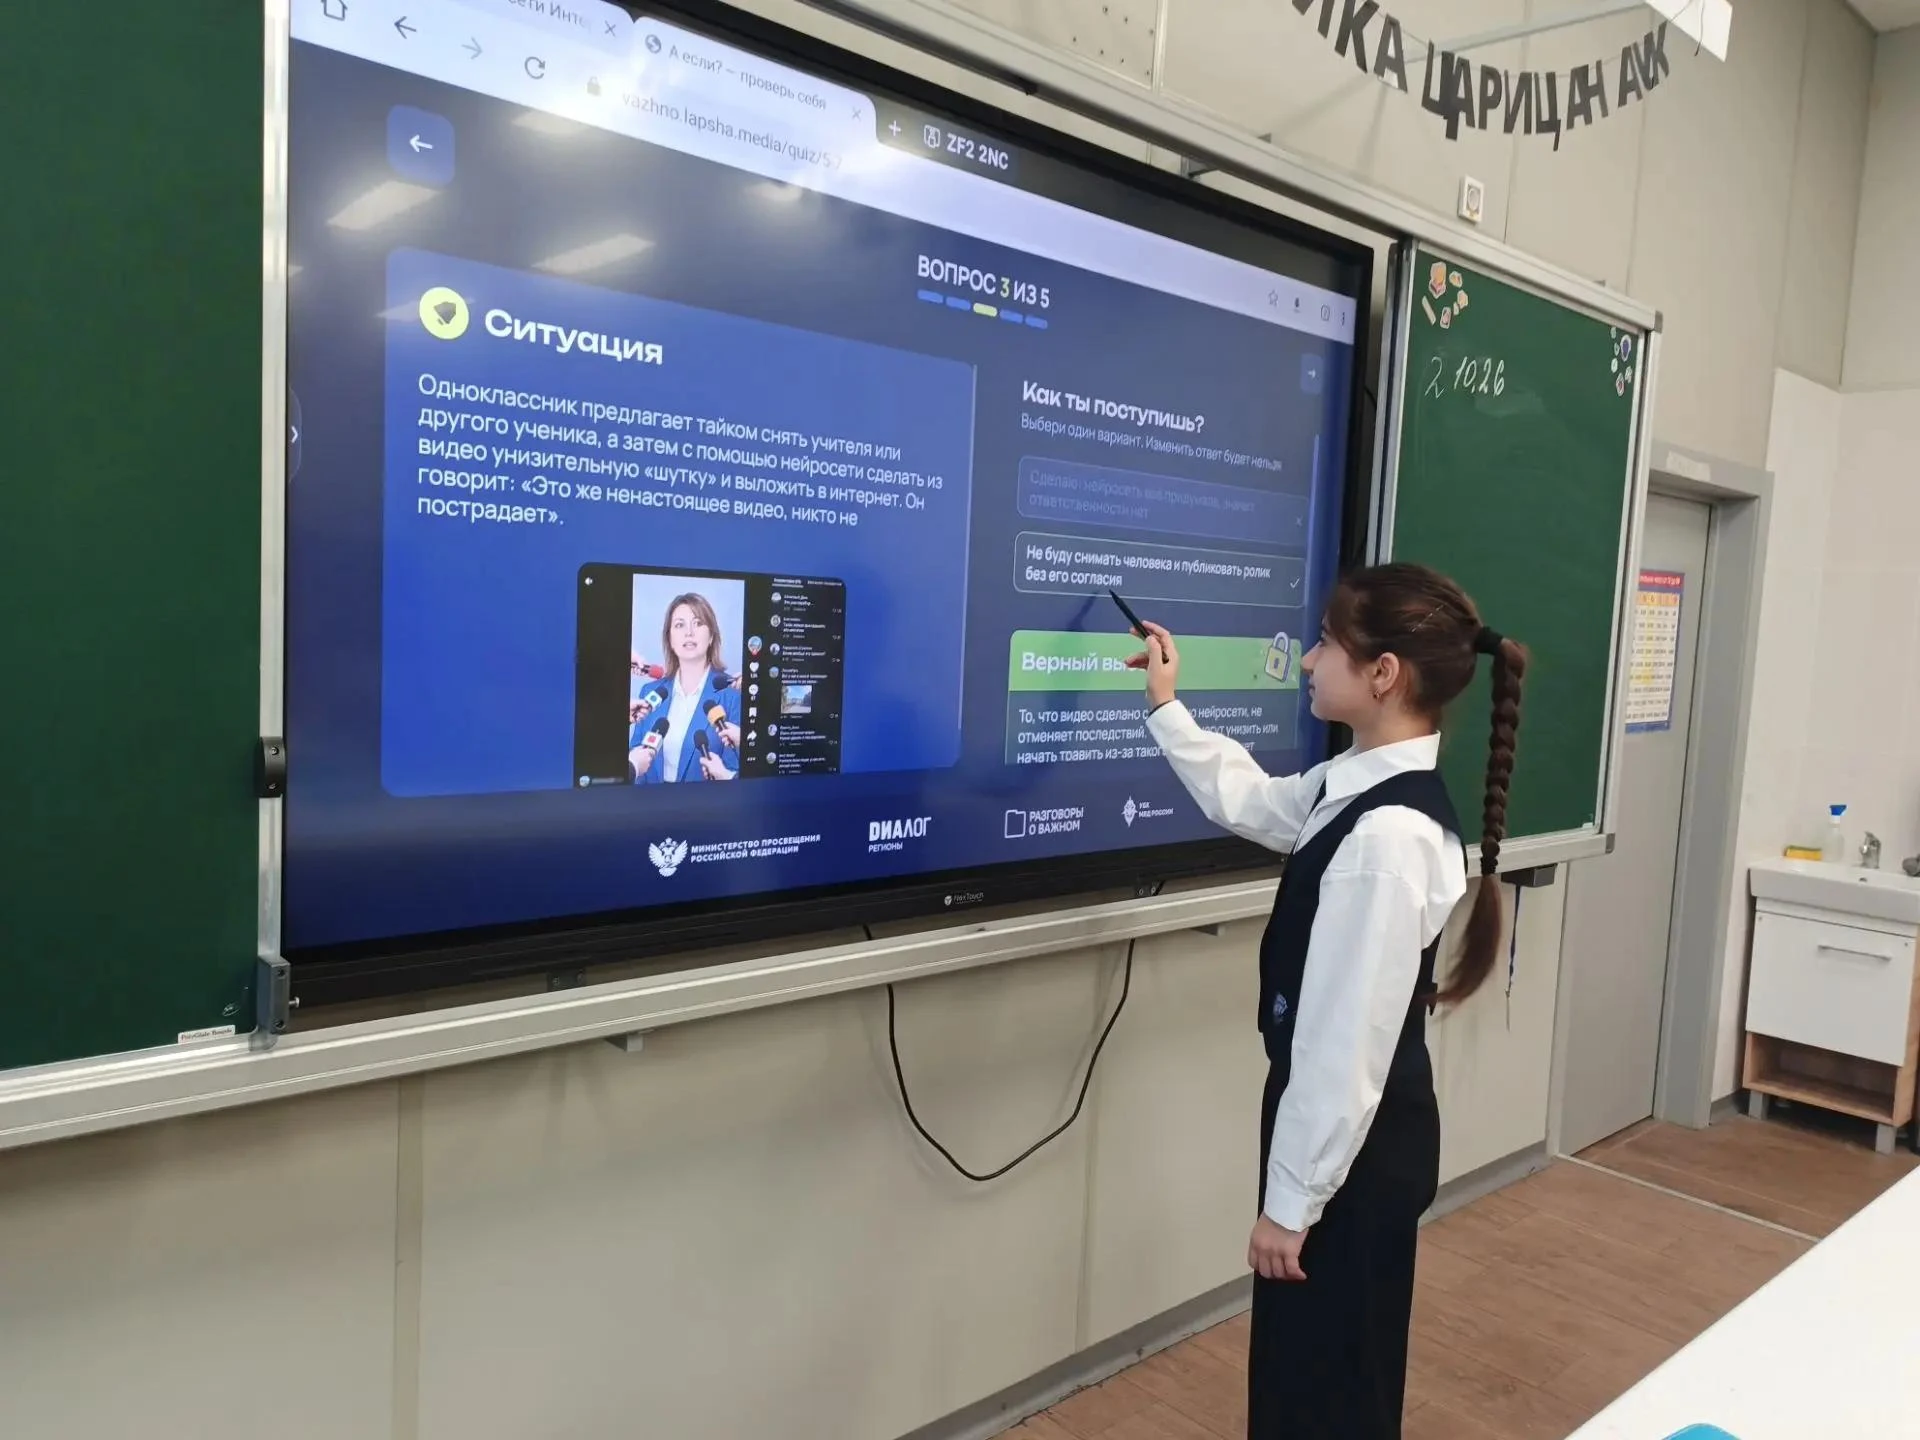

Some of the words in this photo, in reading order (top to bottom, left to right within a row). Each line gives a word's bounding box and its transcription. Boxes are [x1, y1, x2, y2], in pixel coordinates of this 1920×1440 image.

[669, 44, 680, 60] А
[682, 52, 723, 73] если?
[740, 69, 795, 101] проверь
[797, 91, 827, 110] себя
[947, 132, 975, 159] ZF2
[979, 142, 1009, 170] 2NC
[917, 254, 997, 294] ВОПРОС
[1000, 276, 1010, 298] 3
[1013, 280, 1037, 305] ИЗ
[1040, 287, 1050, 309] 5
[484, 308, 663, 365] Ситуация
[1424, 356, 1445, 399] 2
[418, 373, 578, 416] Одноклассник
[581, 401, 694, 432] предлагает
[696, 416, 758, 441] тайком
[761, 428, 808, 448] снять
[811, 435, 872, 457] учителя
[875, 444, 901, 461] или
[1022, 380, 1062, 408] Как
[1064, 392, 1090, 413] ты
[1093, 398, 1205, 433] поступишь?
[418, 407, 509, 434] другого
[513, 420, 602, 449] ученика,
[607, 433, 619, 449] а
[622, 435, 678, 456] затем
[682, 443, 693, 458] с
[696, 444, 778, 469] помощью
[780, 455, 864, 480] нейросети
[866, 467, 925, 487] сделать
[927, 475, 943, 490] из
[1021, 412, 1066, 437] Выбери
[1067, 424, 1096, 440] один
[1097, 429, 1144, 448] вариант.
[1195, 447, 1223, 461] ответ
[1223, 448, 1251, 466] будет
[418, 437, 488, 462] видео
[492, 446, 640, 481] унизительную
[644, 466, 717, 490] «шутку»
[721, 473, 732, 489] и
[735, 475, 815, 498] выложить
[818, 485, 827, 499] в
[829, 487, 903, 508] интернет.
[905, 492, 925, 510] Он
[417, 497, 564, 526] пострадает».
[418, 467, 515, 495] говорит:
[521, 475, 571, 498] «Это
[575, 483, 603, 501] же
[606, 487, 730, 513] ненастоящее
[734, 500, 787, 521] видео,
[791, 506, 837, 524] никто
[839, 511, 858, 527] не
[1025, 565, 1047, 582] без
[1048, 569, 1069, 583] его
[1070, 571, 1123, 587] согласия
[1026, 544, 1043, 561] Не
[1044, 545, 1073, 567] буду
[1074, 550, 1122, 567] снимать
[1122, 555, 1172, 572] человека
[1173, 560, 1181, 572] и
[1181, 559, 1243, 577] публиковать
[1243, 565, 1272, 580] ролик
[1021, 651, 1098, 674] Верный
[1018, 708, 1036, 725] То,
[1038, 710, 1059, 723] что
[1060, 710, 1094, 724] видео
[1095, 708, 1141, 723] сделано
[1198, 705, 1250, 721] нейросети,
[1250, 707, 1263, 718] не
[1017, 729, 1074, 744] отменяет
[1075, 724, 1148, 744] последствий.
[1225, 723, 1261, 738] унизить
[1262, 723, 1279, 735] или
[1016, 752, 1058, 765] начать
[1059, 748, 1104, 763] травить
[1104, 746, 1134, 760] из-за
[1028, 823, 1037, 836] О
[1038, 819, 1081, 835] ВАЖНОМ
[1029, 806, 1084, 823] РАЗГОВОРЫ
[690, 848, 748, 863] РОССИЙСКОЙ
[750, 845, 799, 858] ФЕДЕРАЦИИ
[691, 839, 760, 854] МИНИСТЕРСТВО
[761, 833, 821, 848] ПРОСВЕЩЕНИЯ
[868, 841, 904, 854] РЕГИОНЫ
